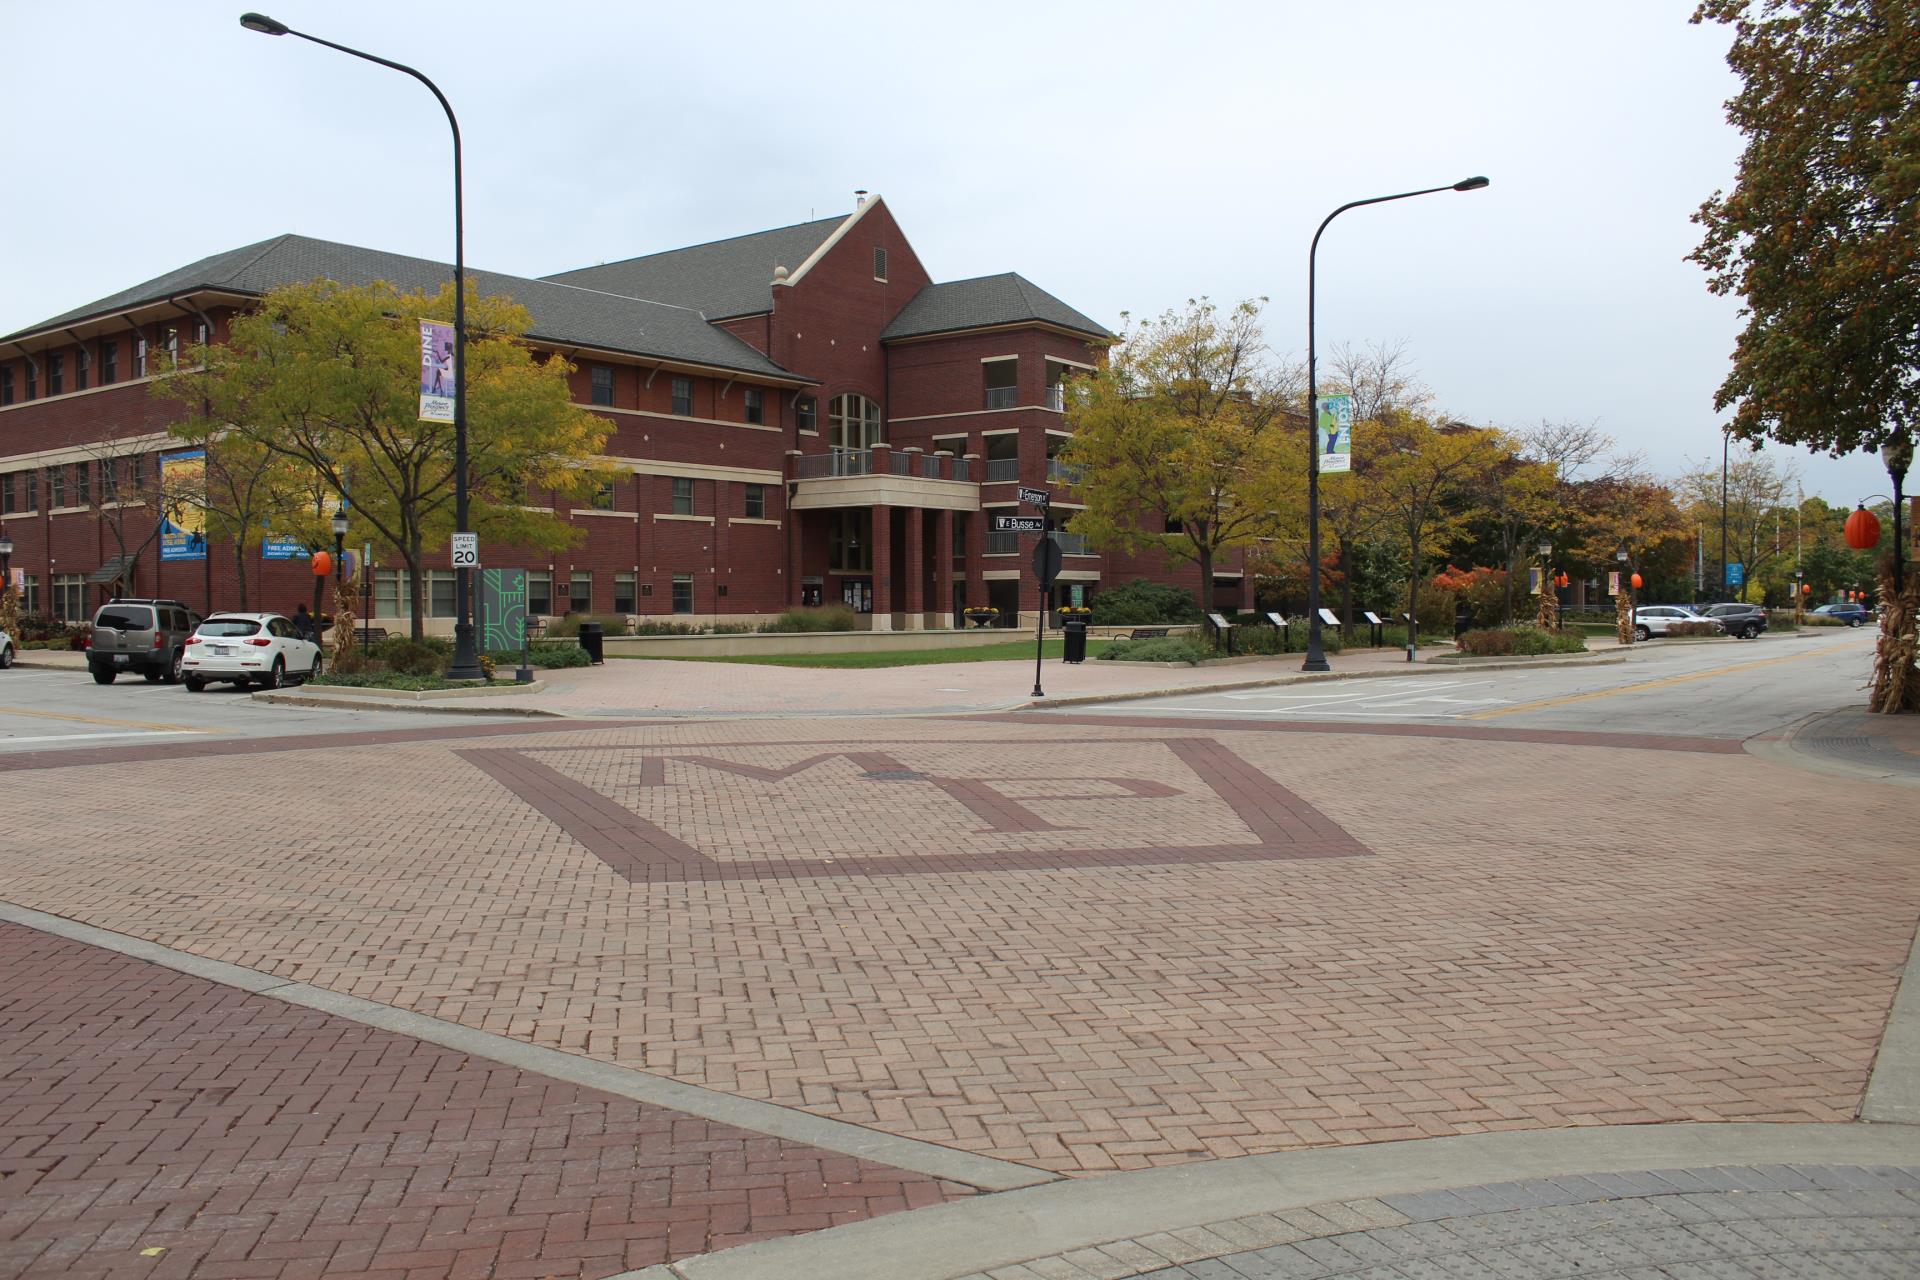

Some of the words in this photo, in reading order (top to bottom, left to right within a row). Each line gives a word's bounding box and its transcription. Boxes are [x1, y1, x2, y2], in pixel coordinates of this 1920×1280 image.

[422, 327, 433, 367] DINE
[1011, 518, 1034, 529] Busse
[454, 551, 475, 563] 20
